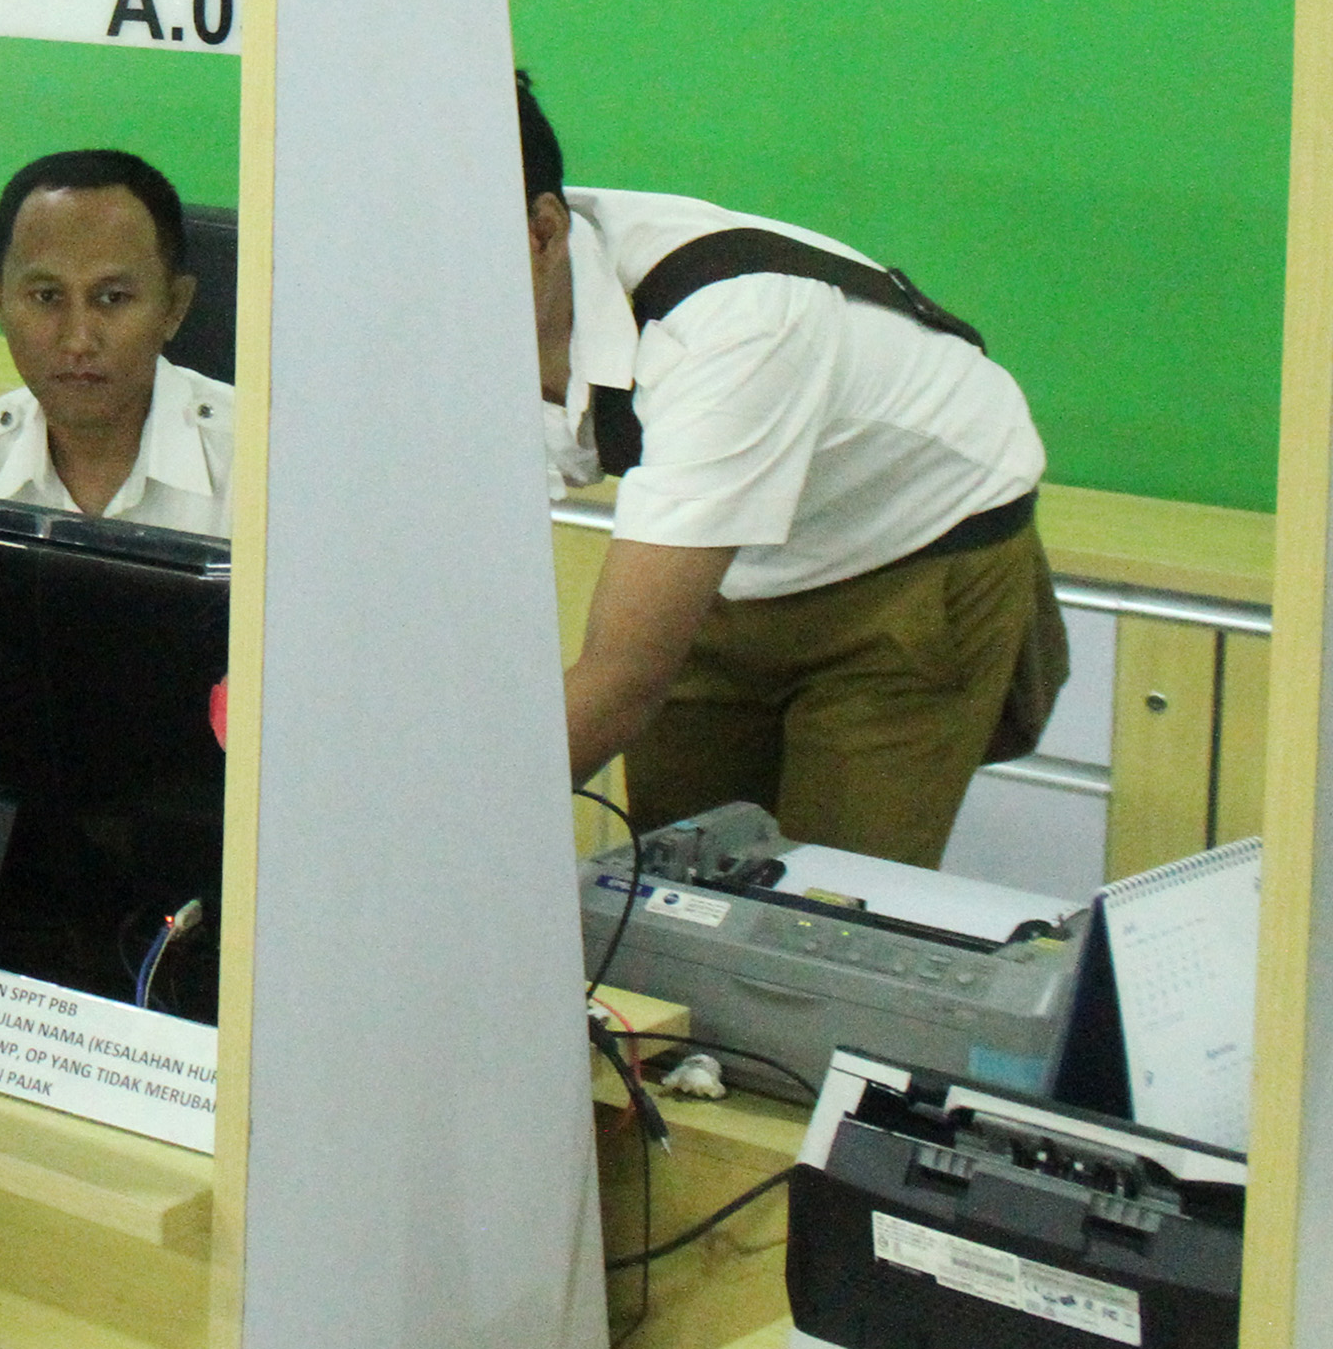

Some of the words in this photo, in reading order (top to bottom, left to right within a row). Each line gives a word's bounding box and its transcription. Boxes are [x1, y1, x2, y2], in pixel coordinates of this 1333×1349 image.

[11, 986, 47, 1009] SPPT
[48, 996, 79, 1018] PBB
[37, 1022, 85, 1048] NAMA
[87, 1034, 185, 1076] (KESALAHAN
[6, 1072, 53, 1097] PAJAK
[25, 1047, 48, 1066] OP
[51, 1055, 92, 1080] YANG
[96, 1067, 141, 1094] TIDAK
[144, 1081, 217, 1114] MERUBA
